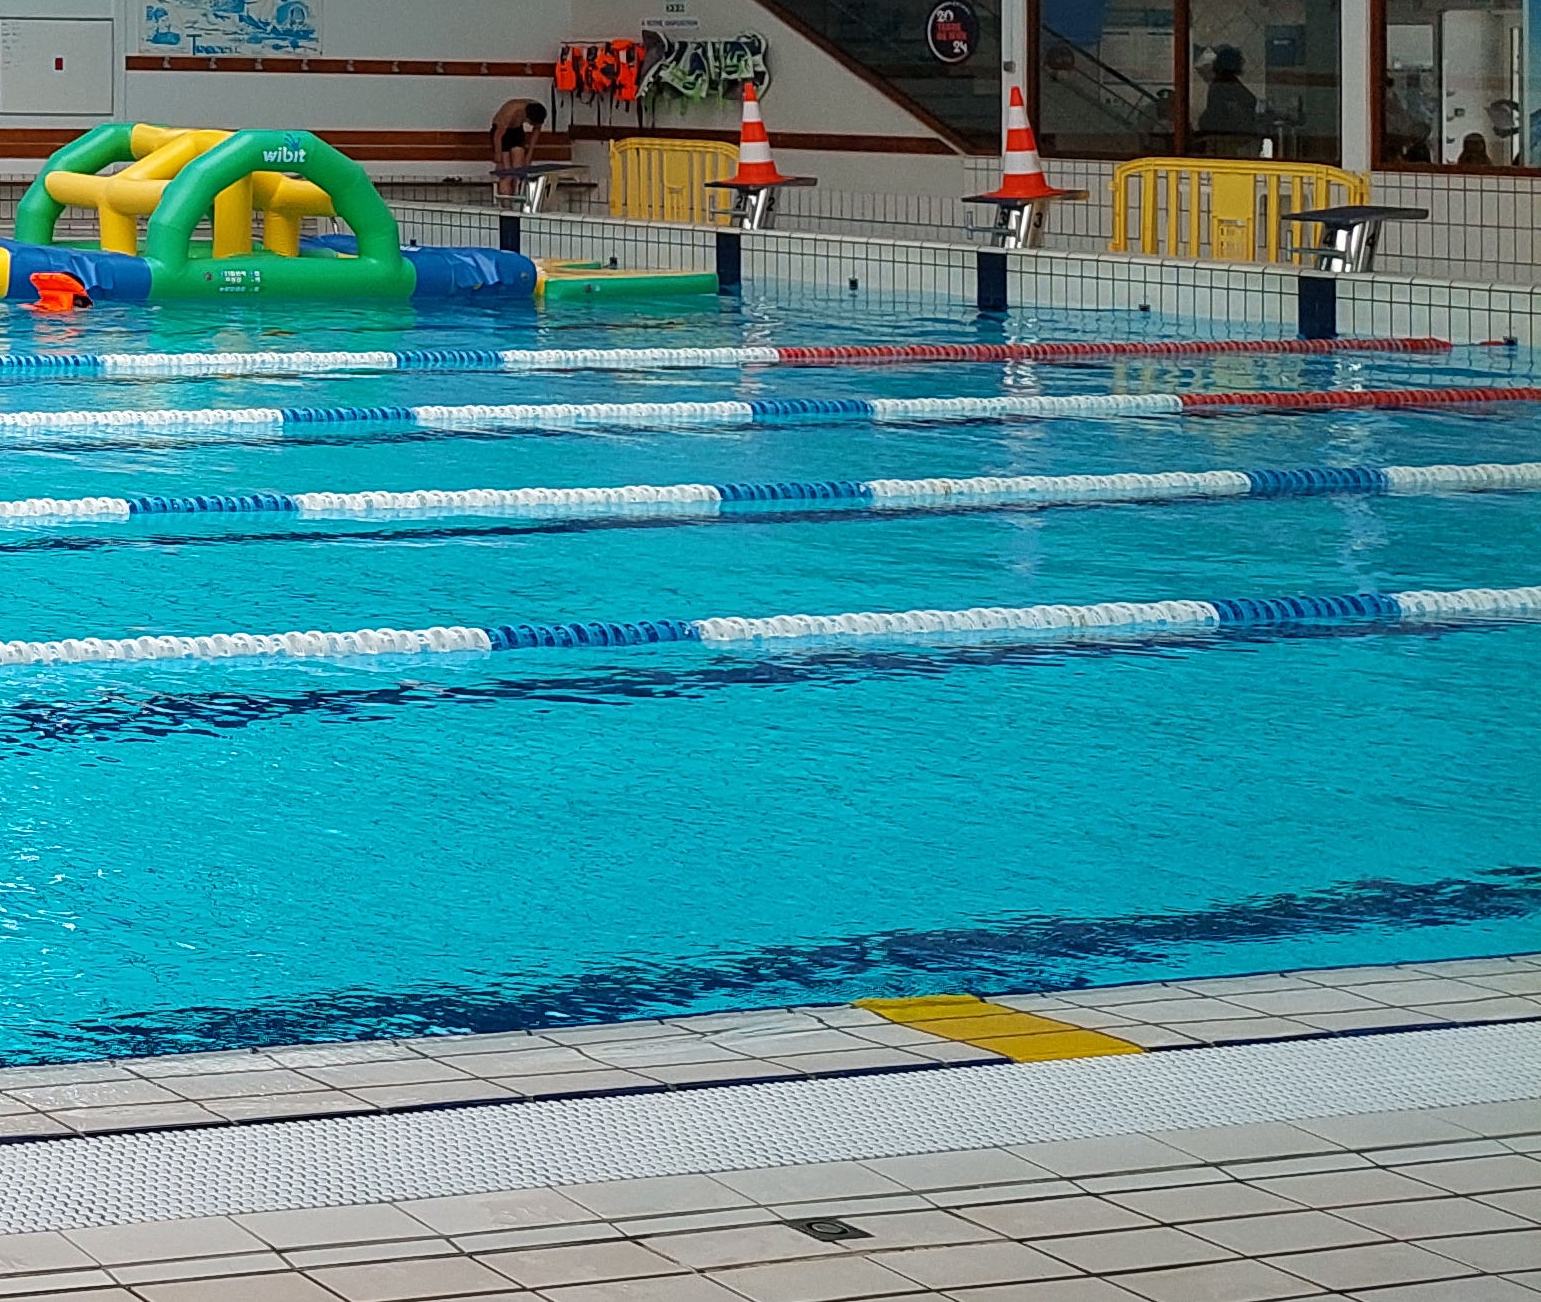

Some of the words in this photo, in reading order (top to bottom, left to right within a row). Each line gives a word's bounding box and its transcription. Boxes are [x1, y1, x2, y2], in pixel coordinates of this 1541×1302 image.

[937, 10, 954, 22] 20
[953, 41, 968, 53] 24
[262, 146, 306, 163] wibit
[545, 183, 551, 198] 1
[766, 196, 775, 211] 2
[1034, 212, 1043, 228] 3
